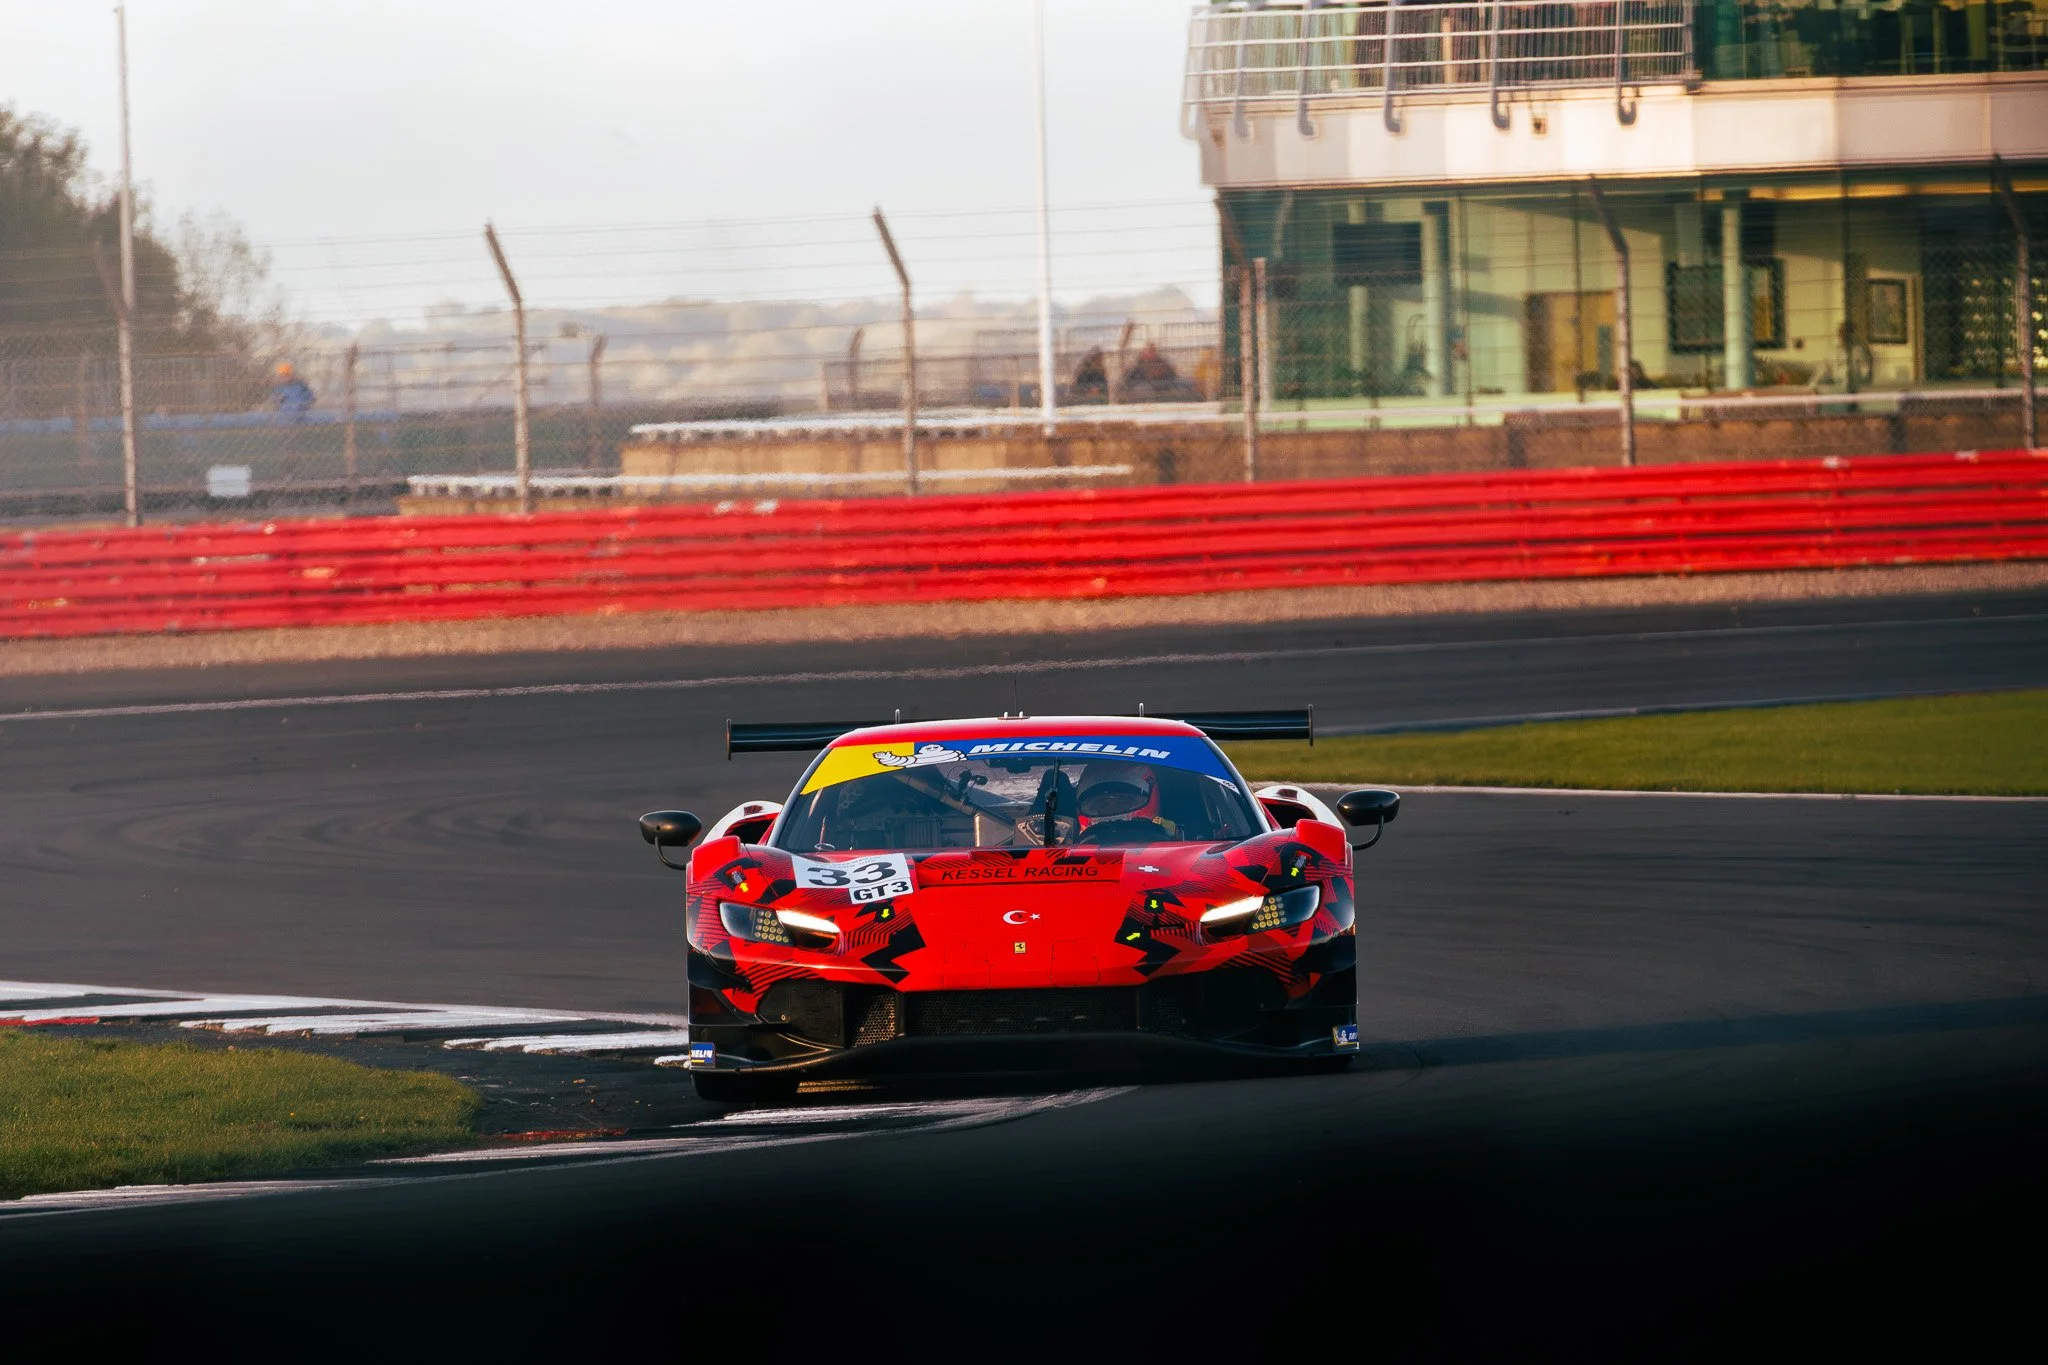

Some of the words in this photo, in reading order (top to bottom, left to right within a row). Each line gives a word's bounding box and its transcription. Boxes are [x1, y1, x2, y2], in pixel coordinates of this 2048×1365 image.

[969, 742, 1171, 759] MICHELIN
[807, 862, 897, 886] 33
[941, 867, 1018, 881] KESSEL
[1024, 866, 1099, 878] RACING
[853, 881, 909, 901] GT3
[690, 1049, 713, 1059] HELIN
